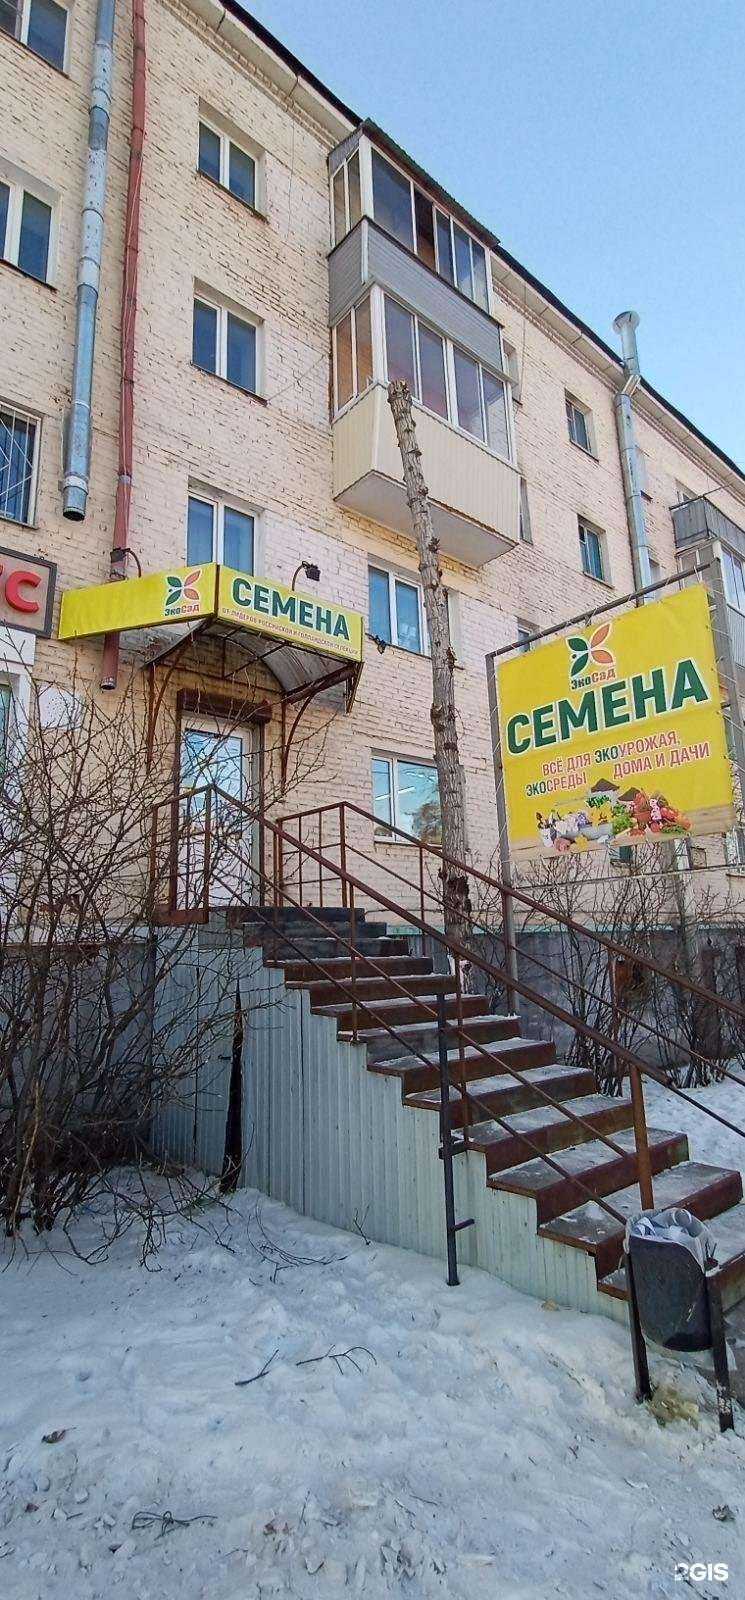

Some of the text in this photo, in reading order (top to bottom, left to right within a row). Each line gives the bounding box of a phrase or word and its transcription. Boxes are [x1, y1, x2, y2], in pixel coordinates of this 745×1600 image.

[232, 577, 350, 640] СЕМЕНА
[507, 659, 709, 754] СЕМЕНА
[571, 668, 616, 690] ЭкоСад
[526, 742, 710, 797] ЭКОСРЕДЫ ДОМА И ДАЧИ
[542, 731, 681, 776] ВСЁ ДЛЯ ЭКОУРОЖАЯ,
